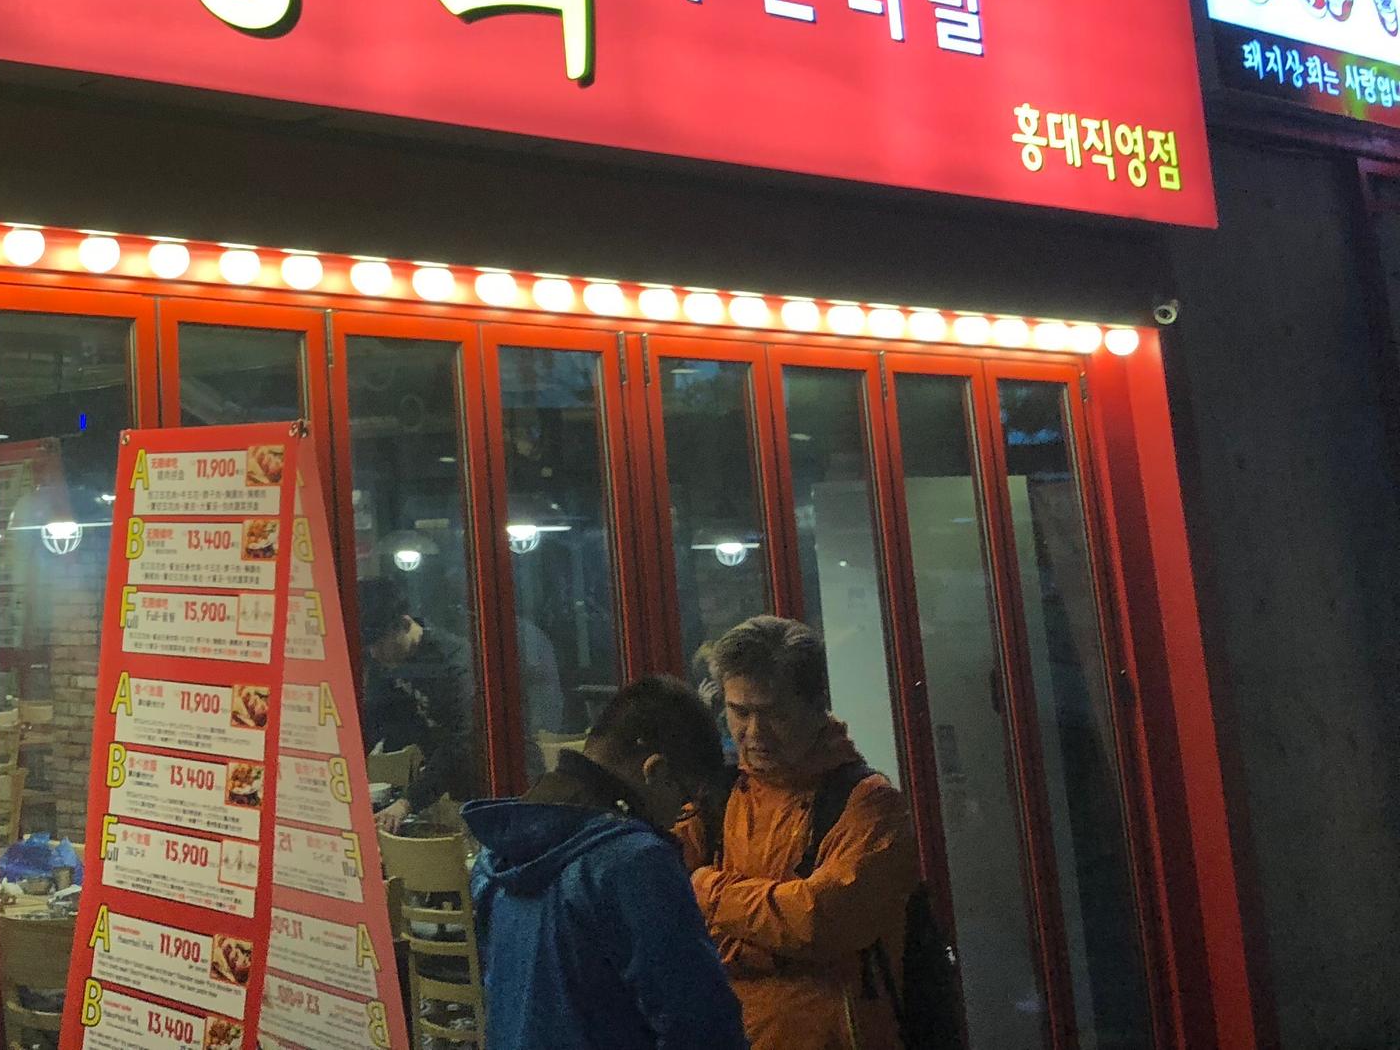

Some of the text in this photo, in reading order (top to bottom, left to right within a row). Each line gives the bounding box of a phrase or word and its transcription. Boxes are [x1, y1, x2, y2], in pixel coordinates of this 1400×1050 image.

[1242, 39, 1340, 96] 돼지상회는
[1011, 102, 1182, 191] 홍대직영점
[130, 449, 150, 491] A
[196, 458, 237, 480] 11,900
[126, 518, 145, 560] B
[187, 530, 232, 552] 13,400
[184, 600, 227, 624] 15,900
[110, 672, 133, 717] A
[179, 690, 221, 715] 11,900
[106, 742, 126, 788] B
[170, 765, 215, 791] 13,400
[165, 838, 209, 868] 15,900
[89, 904, 111, 953] A
[159, 932, 202, 965] 11,900
[81, 977, 102, 1028] B
[147, 1010, 193, 1045] 13,400
